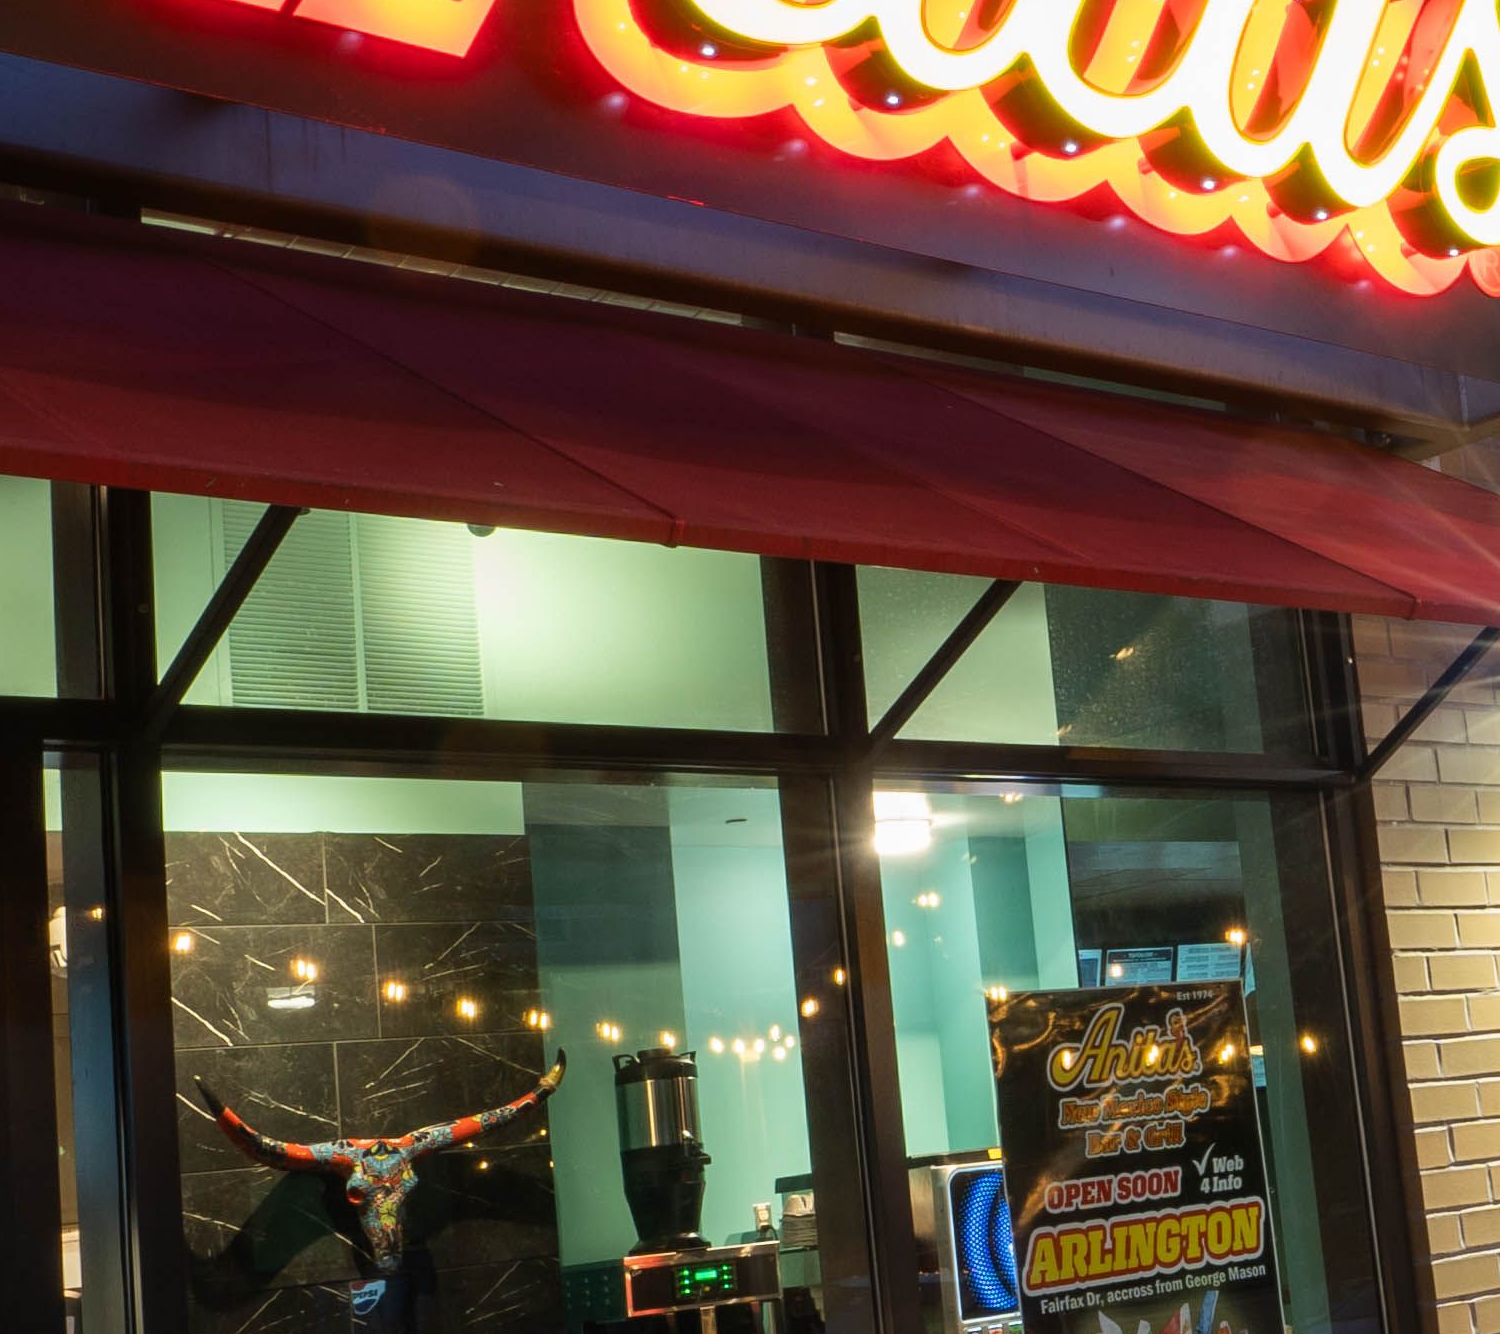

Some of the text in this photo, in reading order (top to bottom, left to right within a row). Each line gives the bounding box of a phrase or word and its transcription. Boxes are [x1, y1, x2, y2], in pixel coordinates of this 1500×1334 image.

[1176, 991, 1190, 1001] Est
[1049, 1004, 1201, 1090] Anita's
[1060, 1084, 1209, 1128] New Mexico Style
[1086, 1120, 1185, 1157] Bar & Grill
[1200, 1175, 1242, 1194] 4 Info
[1212, 1155, 1244, 1174] Web
[1046, 1167, 1181, 1212] OPEN SOON
[1026, 1201, 1263, 1290] ARLINGTON
[1041, 1293, 1084, 1315] Fairfax
[1107, 1283, 1154, 1304] accross
[1155, 1279, 1183, 1295] from
[1185, 1270, 1227, 1290] George
[1228, 1264, 1266, 1281] Mason
